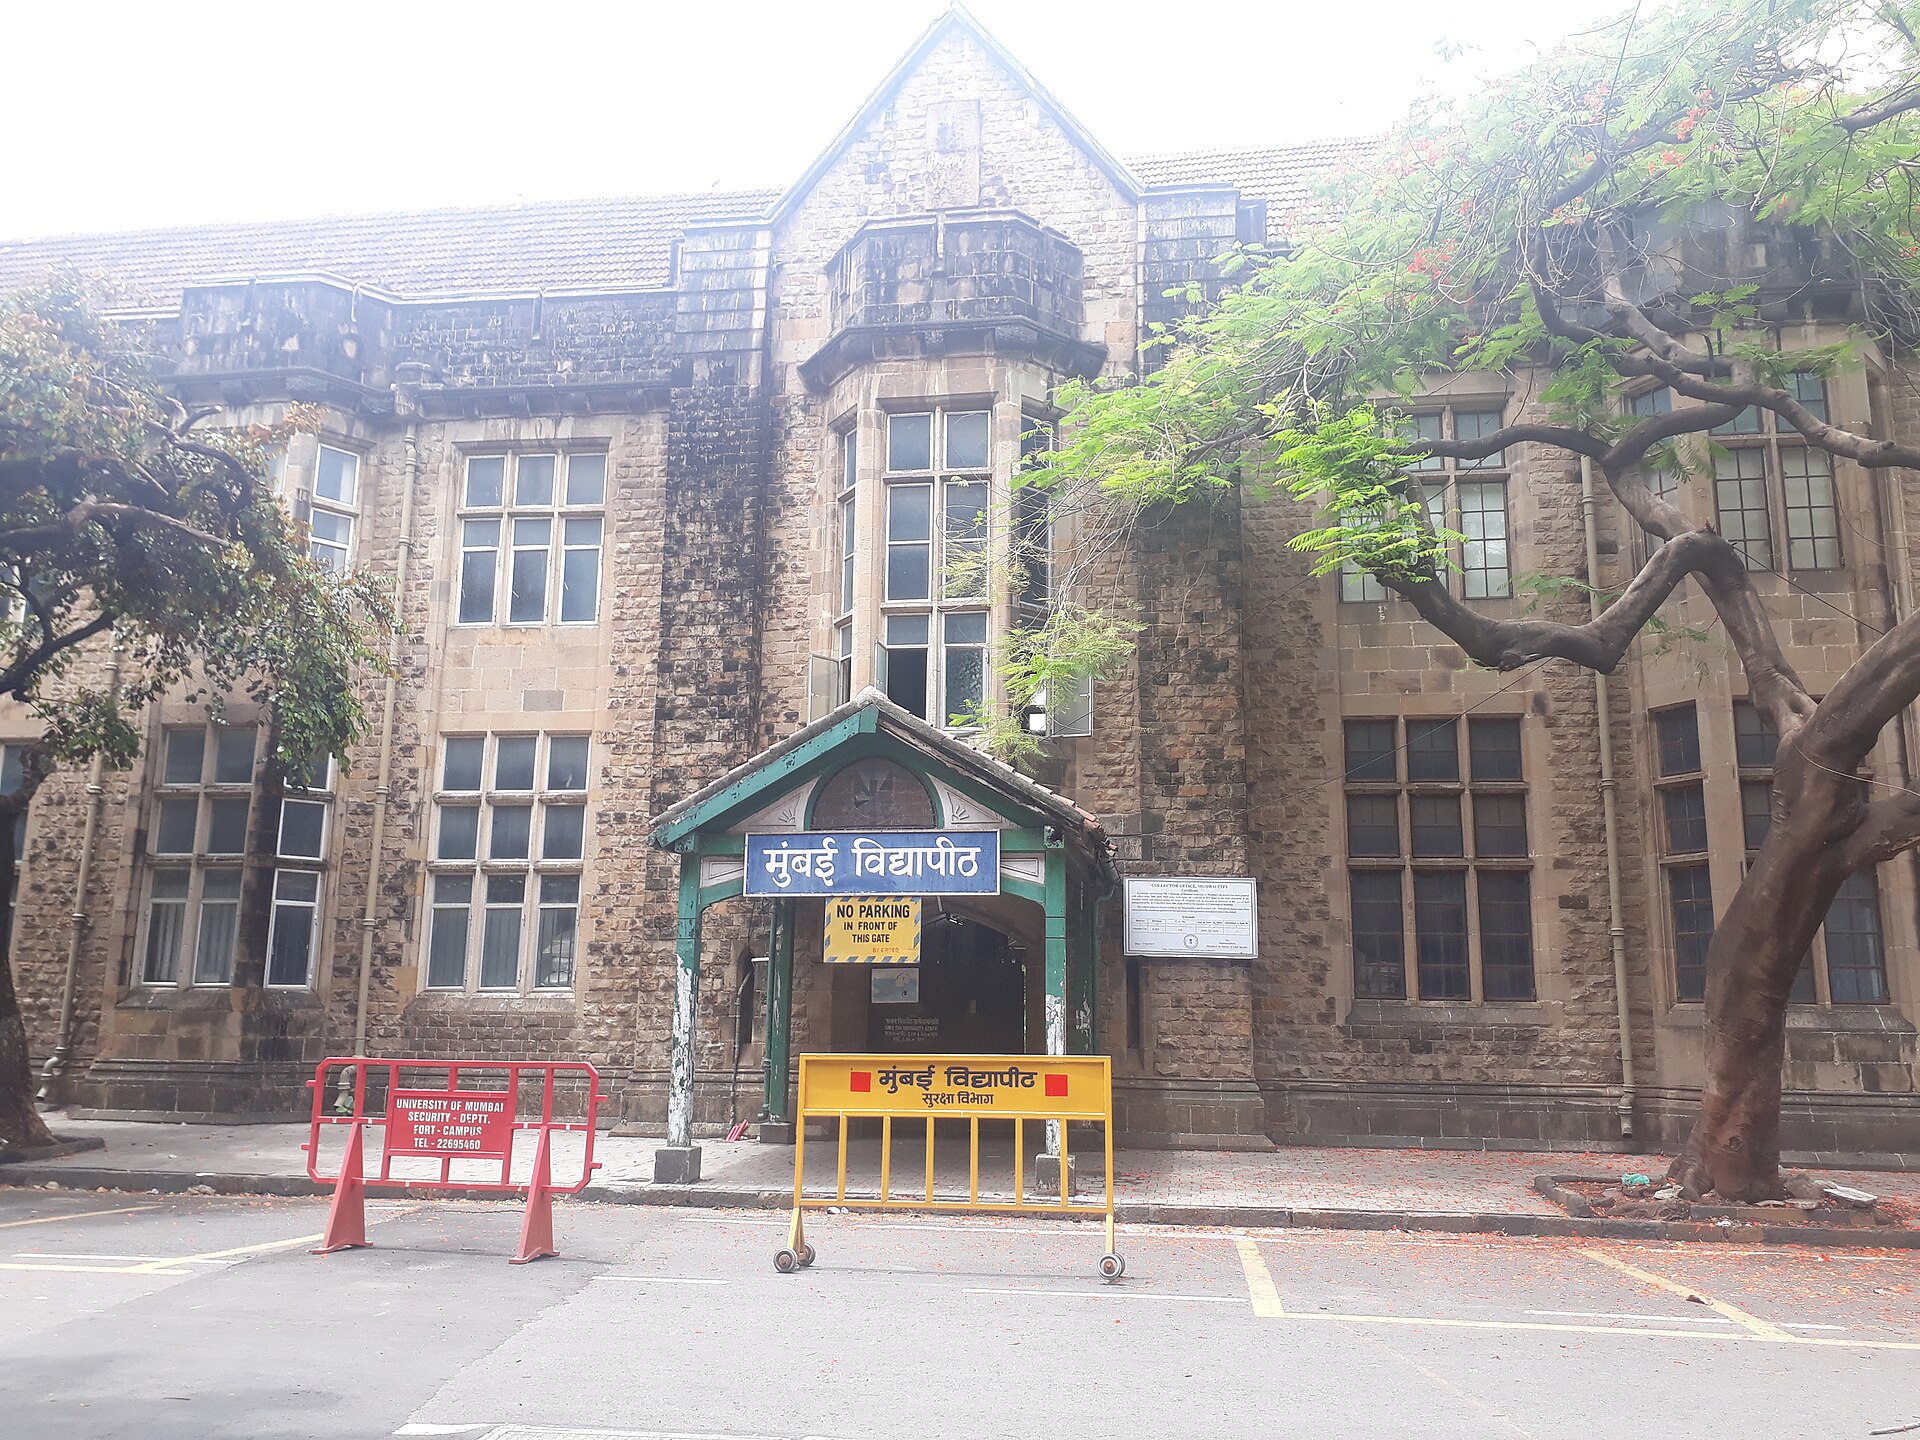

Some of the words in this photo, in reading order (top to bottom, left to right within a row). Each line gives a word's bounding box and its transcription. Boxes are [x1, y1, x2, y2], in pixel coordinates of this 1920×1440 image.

[763, 837, 839, 888] मुंबई
[851, 837, 981, 878] विद्यापीठ
[837, 905, 854, 918] NO
[859, 904, 910, 918] PARKING
[844, 922, 853, 930] IN
[858, 922, 885, 931] FRONT
[888, 922, 898, 930] OF
[852, 934, 870, 943] THIS
[872, 934, 890, 943] GATE
[878, 1065, 935, 1094] मुंबई
[396, 1099, 448, 1110] UNIVERSITY
[450, 1101, 462, 1111] OF
[465, 1101, 504, 1112] MUMBAI
[922, 1092, 955, 1108] सुरक्षा
[957, 1091, 994, 1105] विभाग
[408, 1112, 450, 1122] SECURITY
[460, 1114, 490, 1124] DEPTT.
[414, 1124, 436, 1134] FORT
[443, 1126, 482, 1136] CAMPUS
[414, 1138, 428, 1148] TEL
[436, 1138, 480, 1150] 22695460
